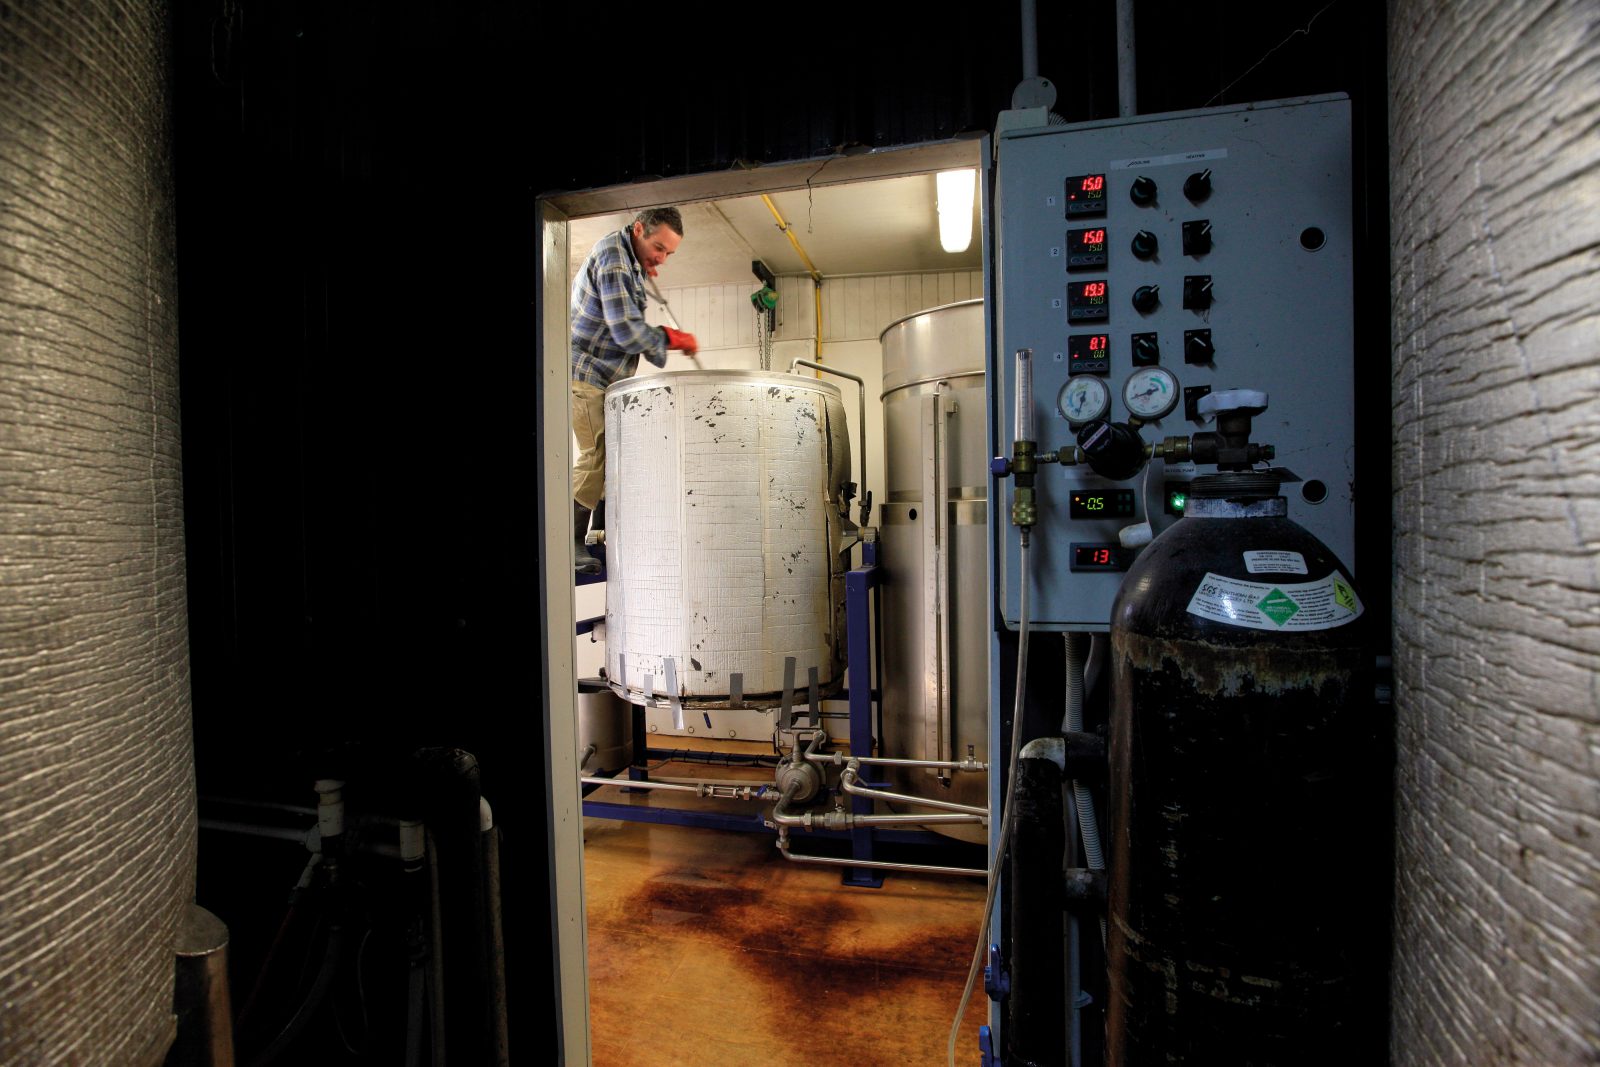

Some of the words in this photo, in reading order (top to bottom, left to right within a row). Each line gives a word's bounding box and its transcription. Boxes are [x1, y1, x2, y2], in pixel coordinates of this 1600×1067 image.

[1081, 176, 1103, 191] 15.0
[1083, 230, 1105, 244] 15.0
[1083, 282, 1105, 297] 19.3
[1089, 336, 1107, 351] 8.7
[1080, 497, 1104, 510] -0.5
[1092, 549, 1110, 563] 13
